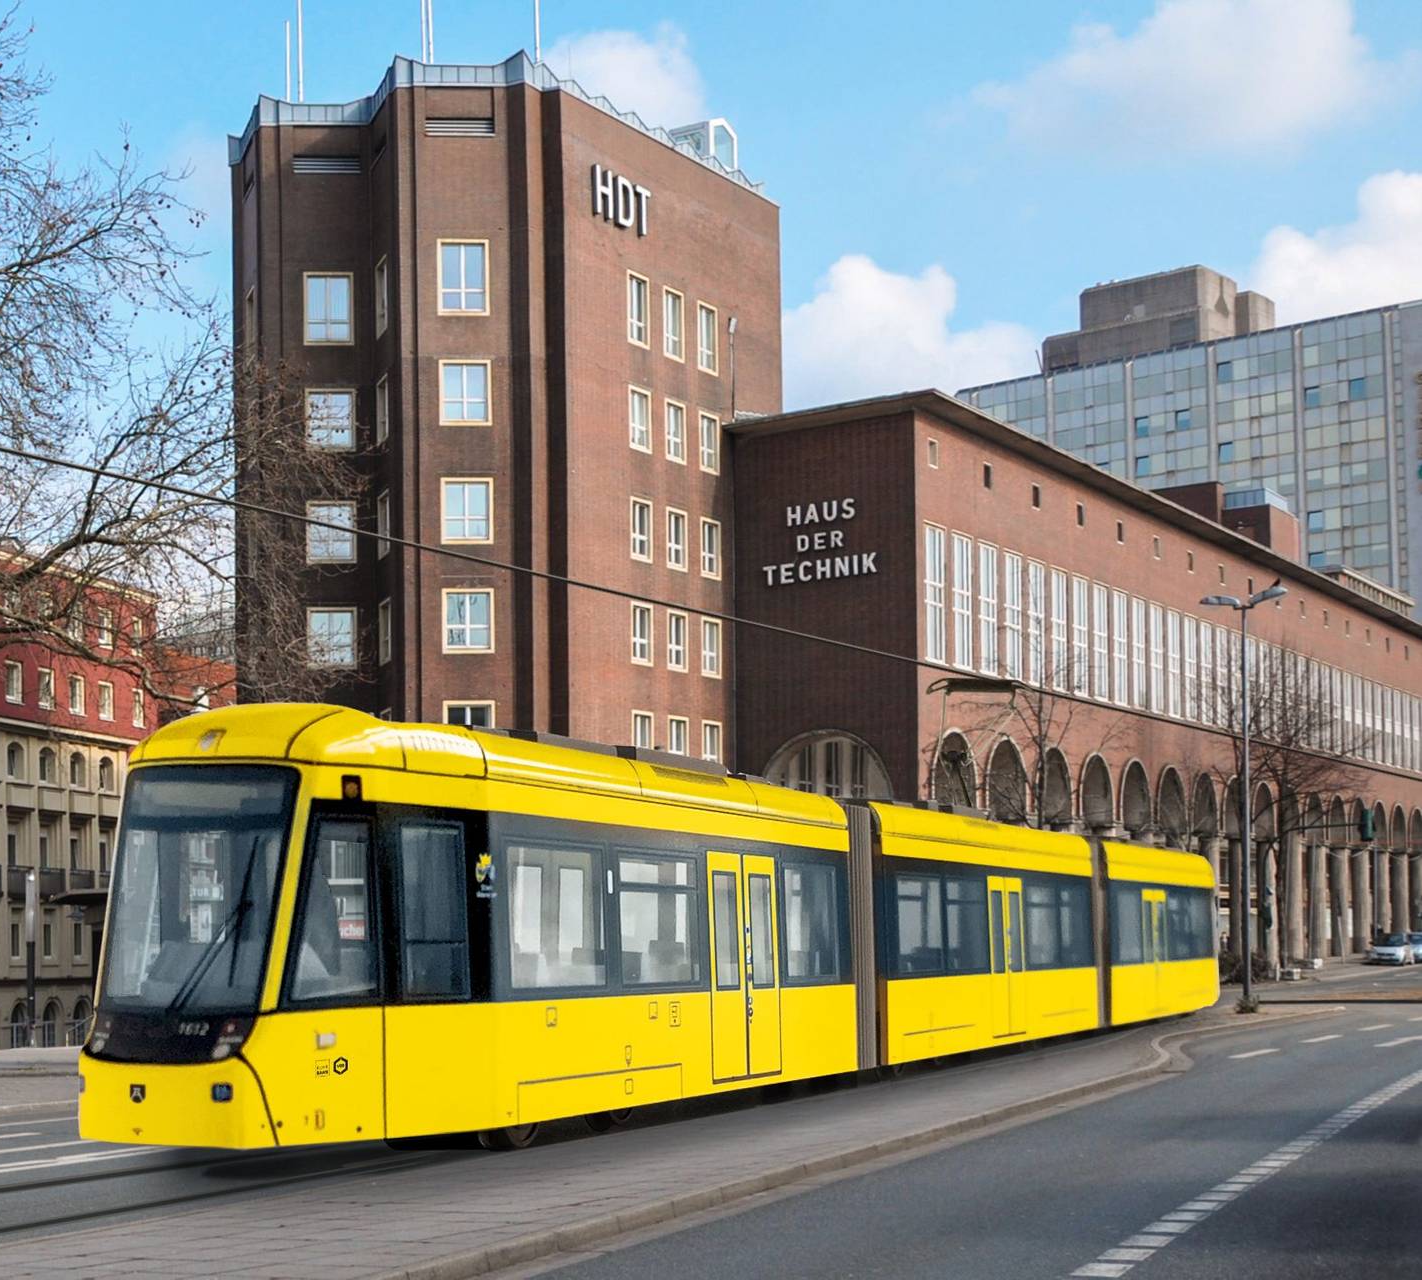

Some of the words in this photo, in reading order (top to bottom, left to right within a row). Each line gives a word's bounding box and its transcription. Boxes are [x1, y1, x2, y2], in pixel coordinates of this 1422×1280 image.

[591, 164, 651, 238] HDT
[786, 498, 856, 527] HAUS
[796, 530, 844, 552] DER
[762, 552, 877, 586] TECHNIK
